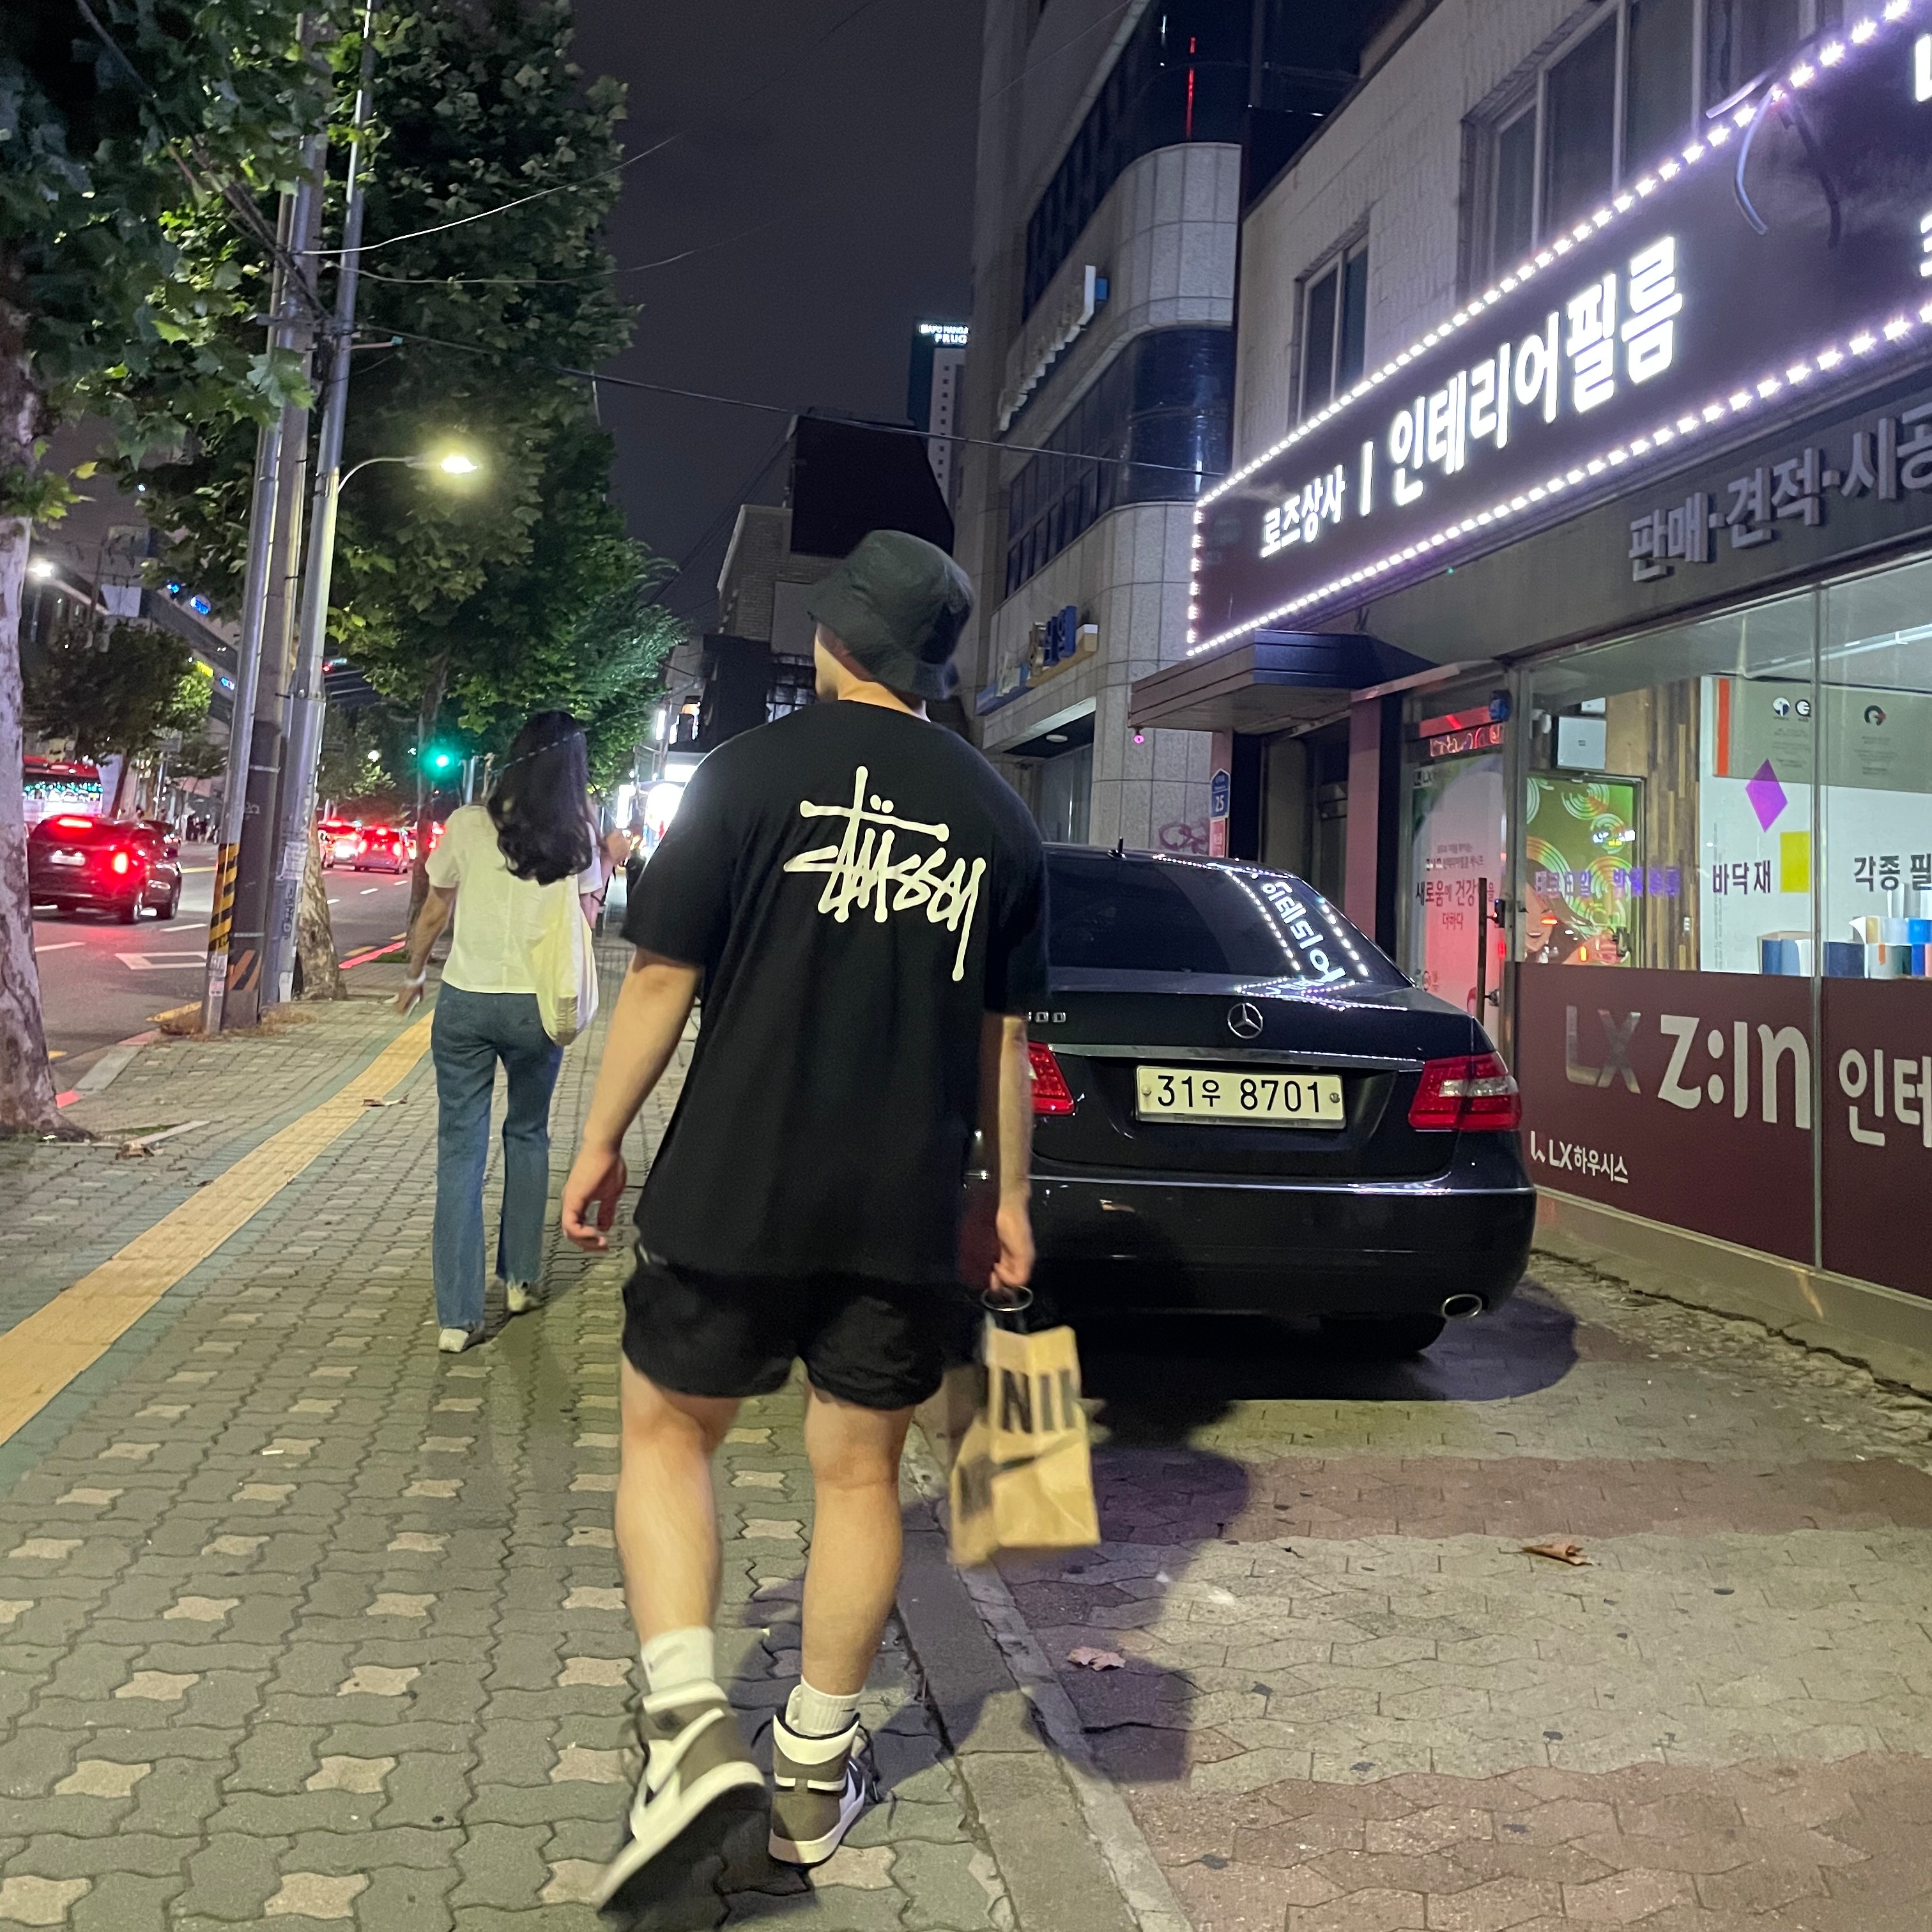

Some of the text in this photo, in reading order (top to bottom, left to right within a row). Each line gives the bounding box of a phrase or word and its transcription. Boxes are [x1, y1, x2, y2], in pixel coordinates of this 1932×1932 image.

[1261, 236, 1683, 558] 로즈상사 인테리어필름
[1712, 859, 1771, 895] 바닥재
[1853, 855, 1901, 893] 각종
[1566, 1005, 1641, 1094] LX
[1157, 1075, 1320, 1113] 31우 8701
